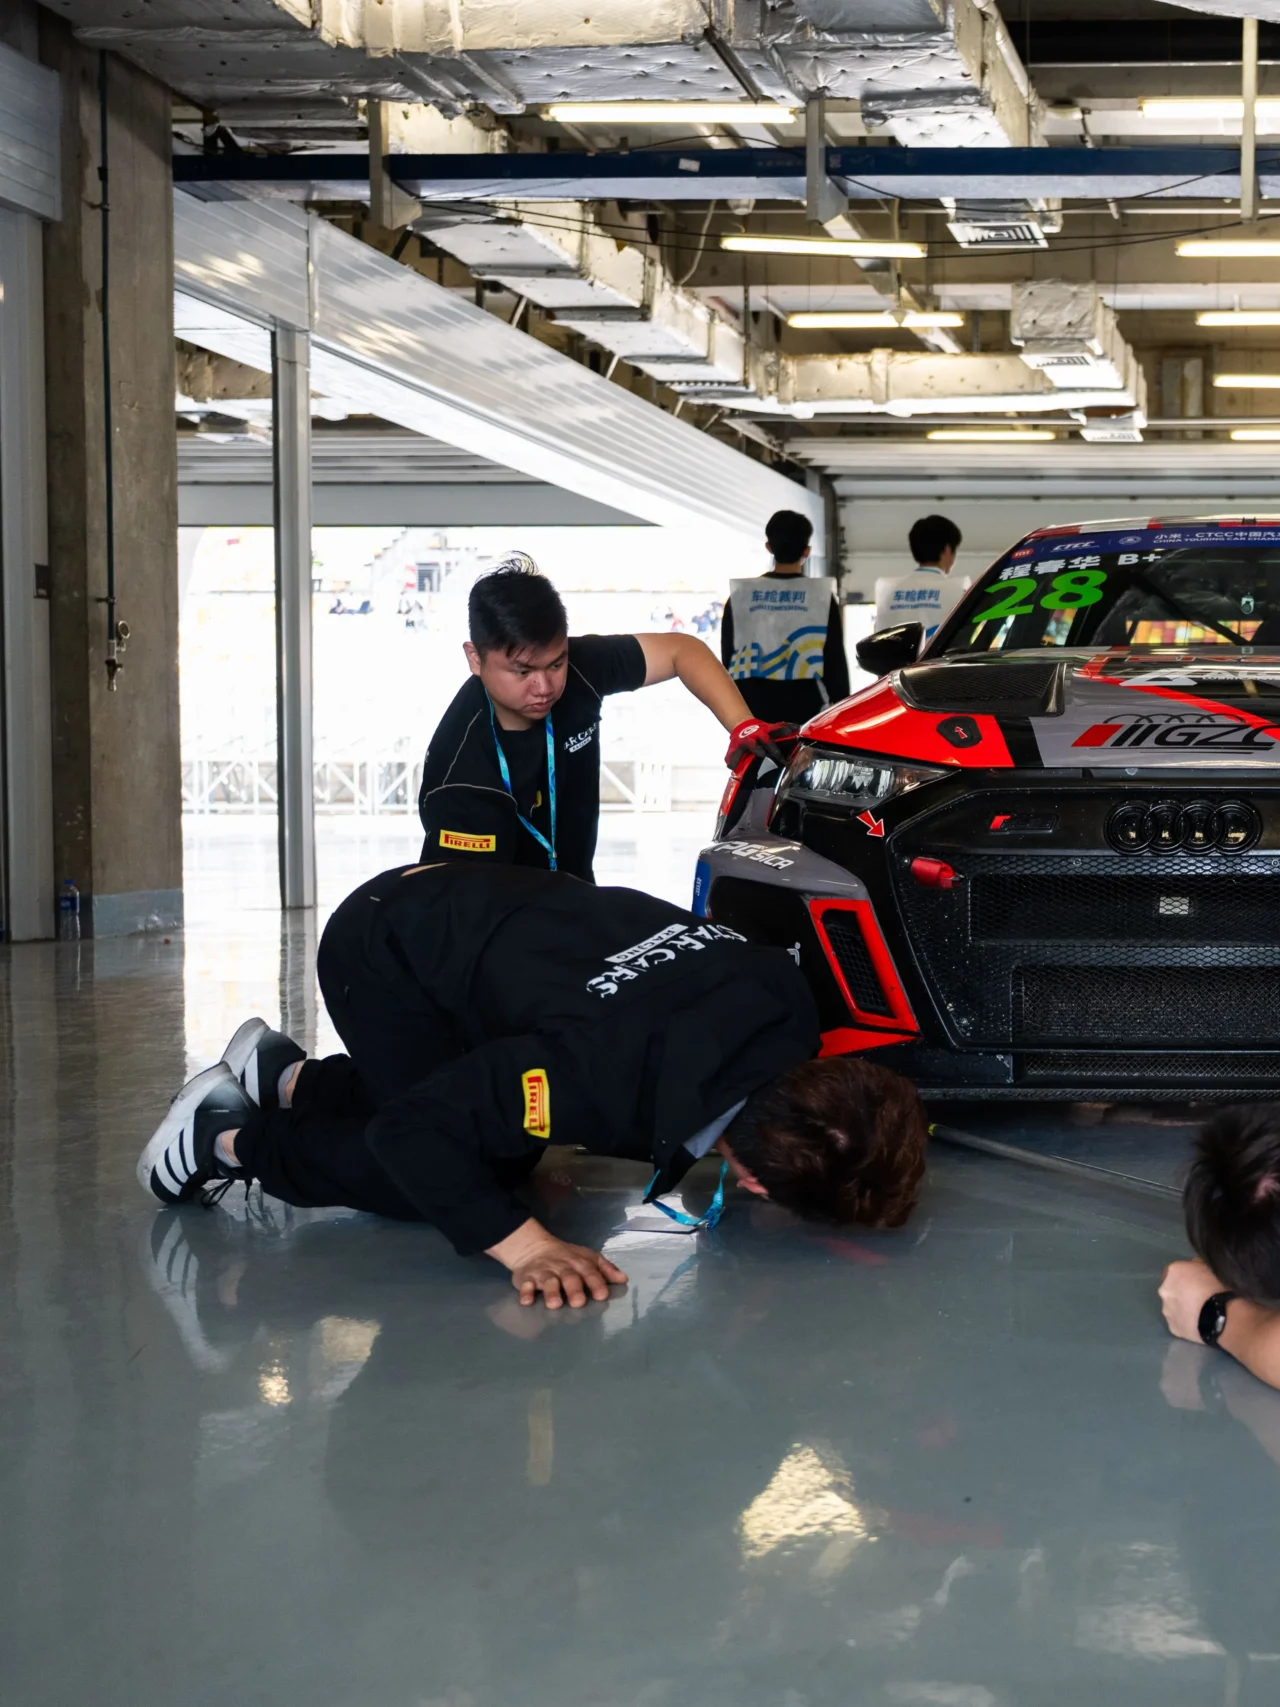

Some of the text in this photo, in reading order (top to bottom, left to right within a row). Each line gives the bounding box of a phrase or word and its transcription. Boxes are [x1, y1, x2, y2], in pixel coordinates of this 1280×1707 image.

[999, 556, 1102, 582] 程春华
[1117, 553, 1162, 566] B+
[751, 590, 807, 603] 车检裁判
[972, 570, 1108, 624] 28
[444, 833, 491, 849] PIRELLI
[713, 841, 795, 870] PG SICA
[586, 924, 748, 999] STAR CARS
